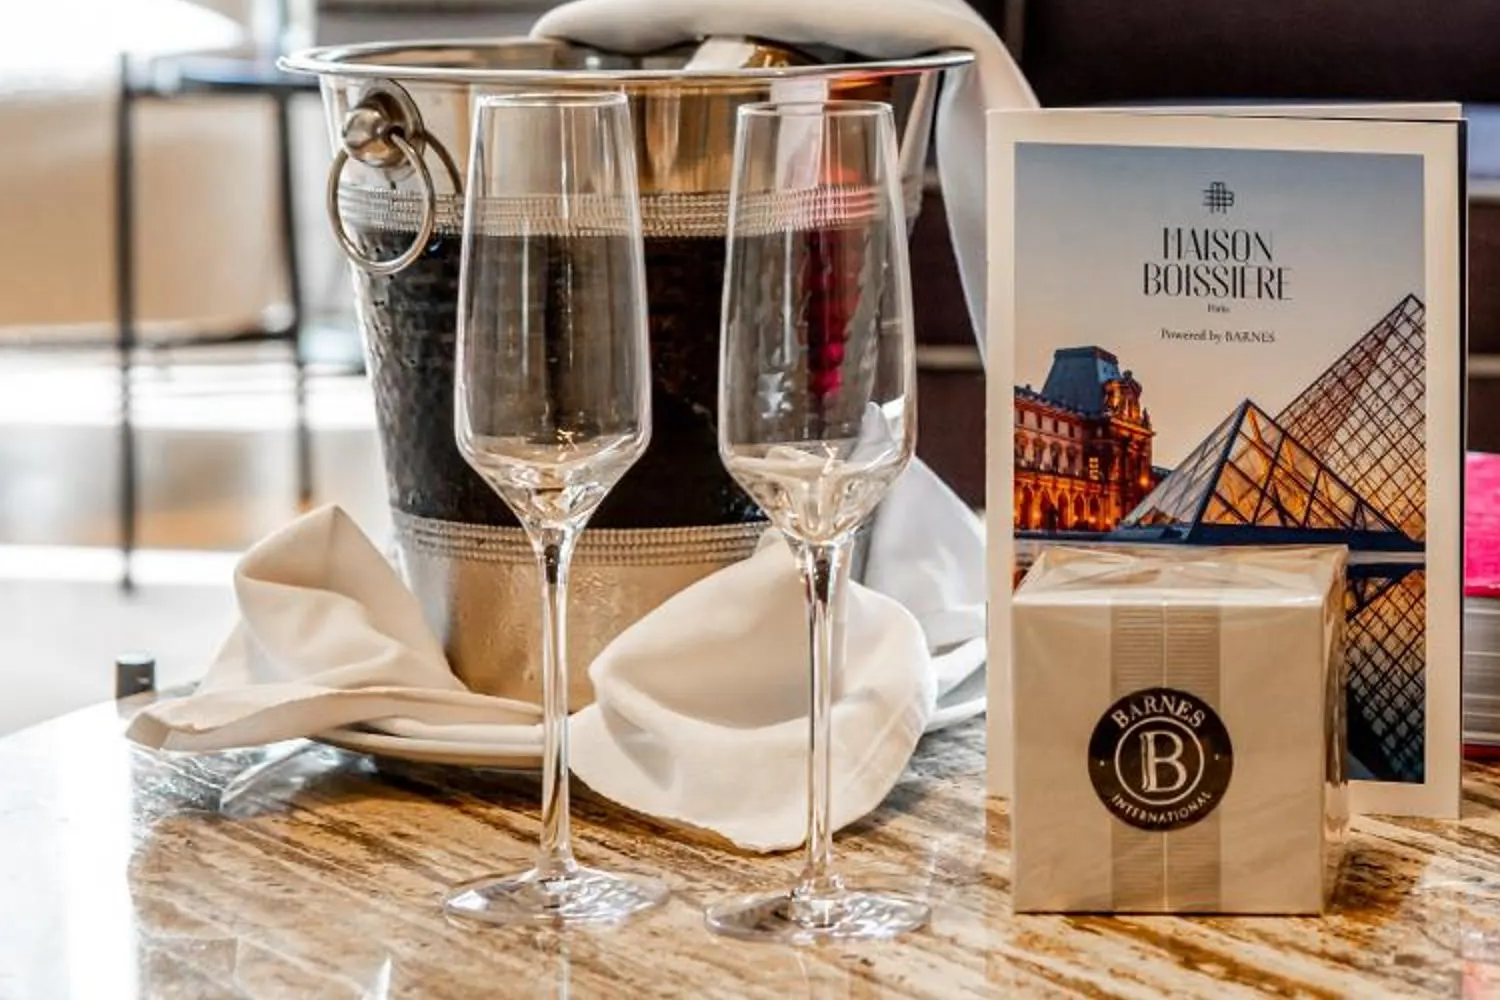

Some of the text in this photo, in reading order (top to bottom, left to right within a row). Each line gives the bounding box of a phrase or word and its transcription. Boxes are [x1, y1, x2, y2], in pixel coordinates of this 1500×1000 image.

[1163, 226, 1273, 262] MAISON
[1161, 328, 1275, 344] Powered by BARNES
[1111, 695, 1206, 729] BARNES
[1139, 730, 1187, 793] B
[1111, 792, 1212, 824] INTERNATIONAL
